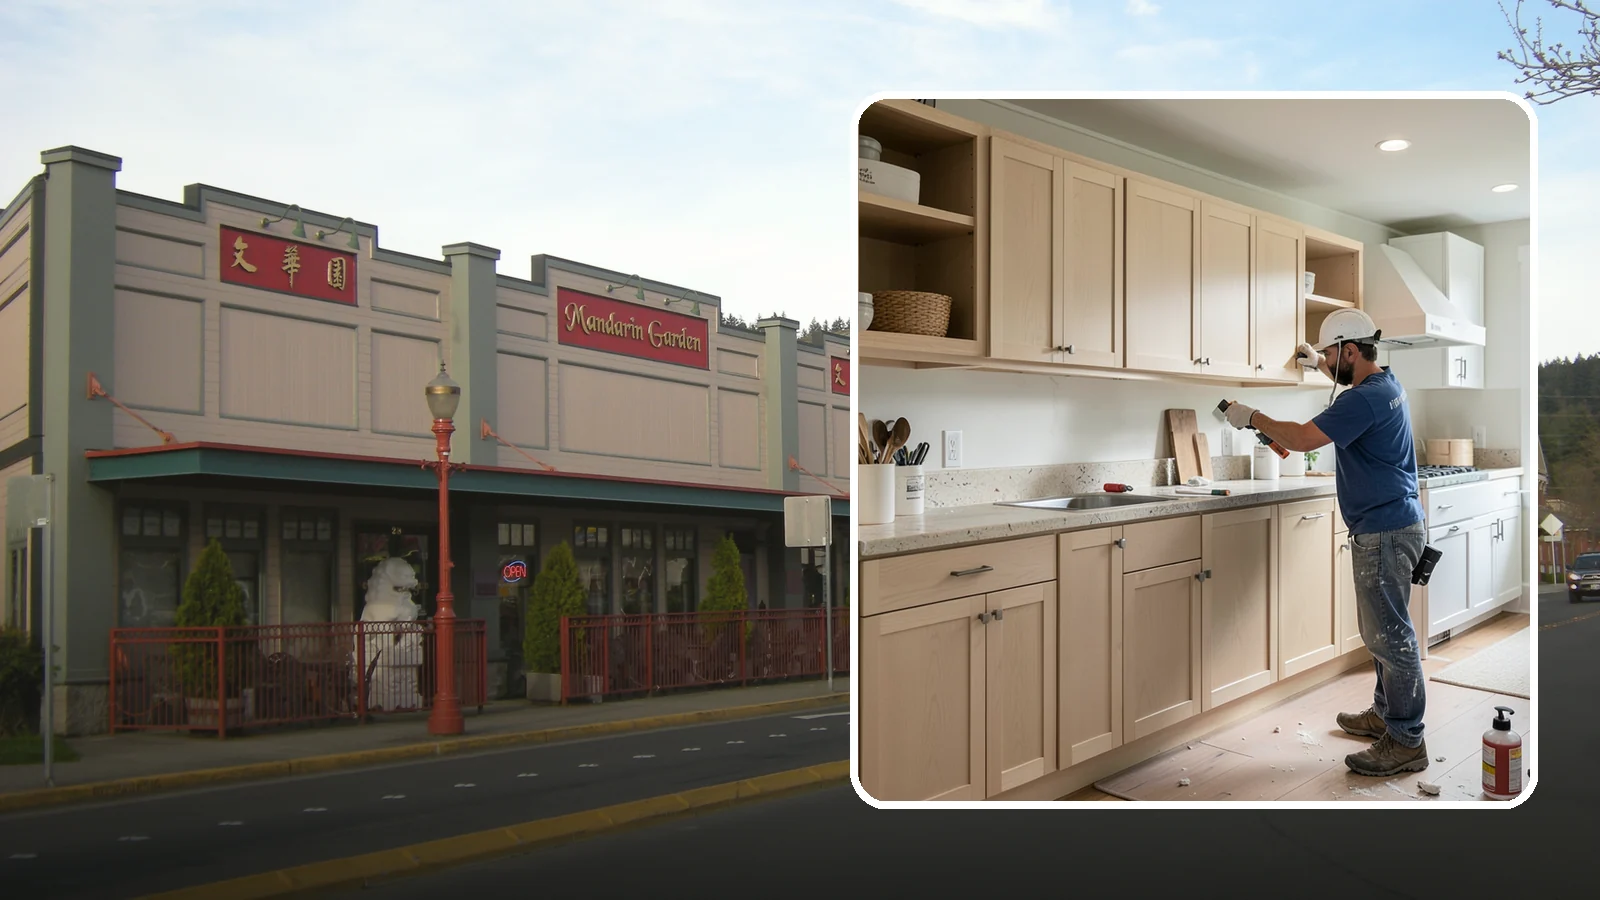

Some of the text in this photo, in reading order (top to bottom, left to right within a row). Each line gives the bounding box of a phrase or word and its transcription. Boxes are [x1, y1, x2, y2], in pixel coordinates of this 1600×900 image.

[230, 235, 347, 291] 文華園
[564, 302, 702, 352] Mandarin Garden
[503, 565, 527, 578] OPEN
